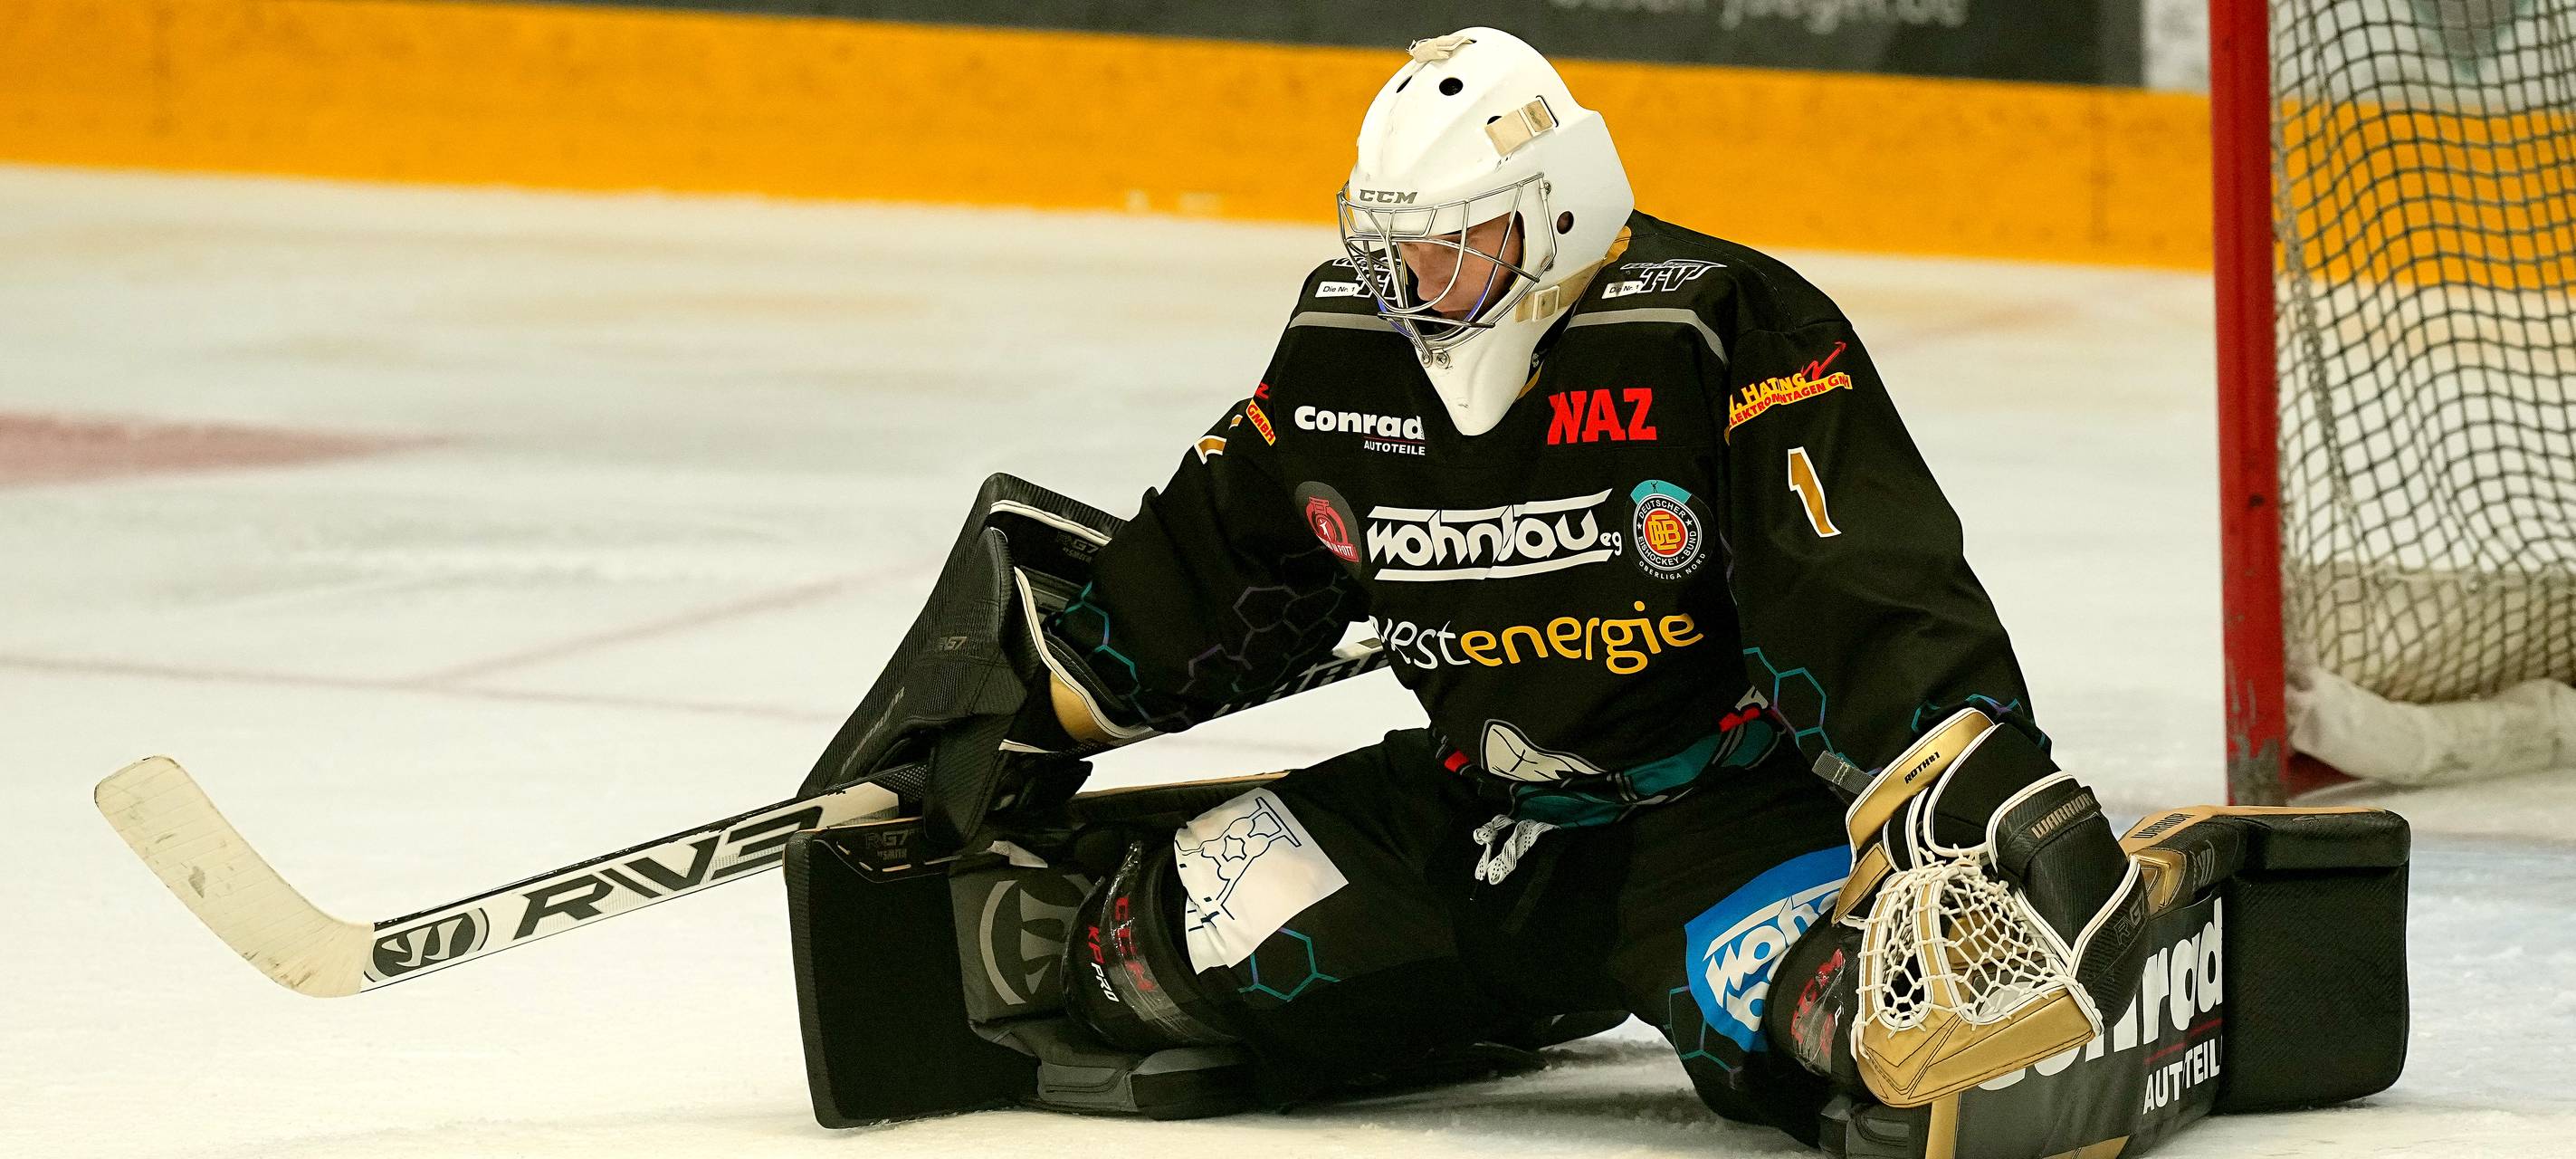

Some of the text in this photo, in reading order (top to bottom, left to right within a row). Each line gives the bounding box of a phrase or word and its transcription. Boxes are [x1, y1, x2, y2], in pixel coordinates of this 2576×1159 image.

[1360, 189, 1417, 204] CCM
[1322, 284, 1338, 292] Die
[1246, 404, 1274, 442] GMBH
[1294, 406, 1426, 440] conrad
[1364, 440, 1426, 455] AUTOTEILE
[1787, 445, 1842, 538] 1
[1638, 499, 1686, 520] DEUTSCHER
[1600, 532, 1622, 556] eg
[1638, 552, 1706, 580] OBERLIGA NORD
[1903, 752, 1941, 784] ROTH#1
[2030, 793, 2094, 839] WARRIOR
[2131, 812, 2197, 838] WARRIOR
[1091, 962, 1120, 1002] PRO
